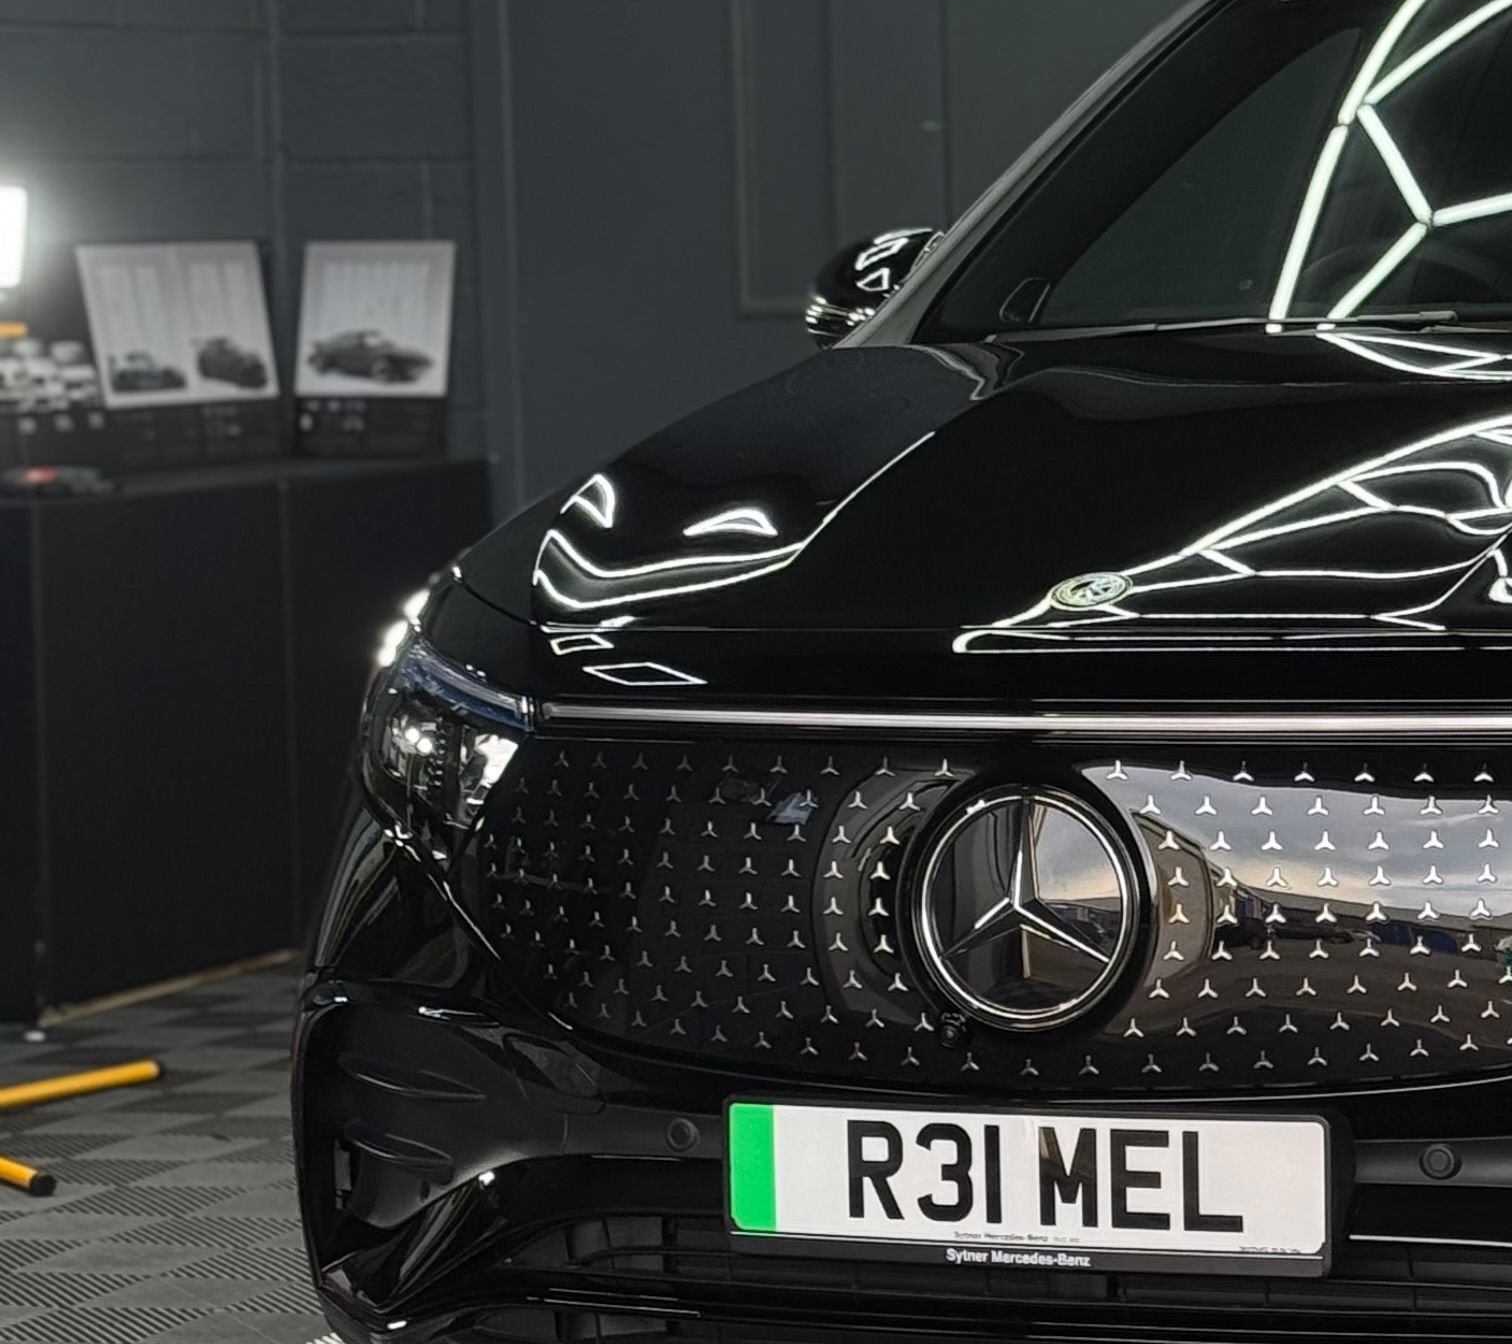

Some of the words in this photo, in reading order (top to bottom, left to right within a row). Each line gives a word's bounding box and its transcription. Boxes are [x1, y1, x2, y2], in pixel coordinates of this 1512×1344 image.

[1038, 1126, 1244, 1233] MEL
[946, 1247, 988, 1265] Sytner
[991, 1249, 1092, 1267] Mercedes-Benz
